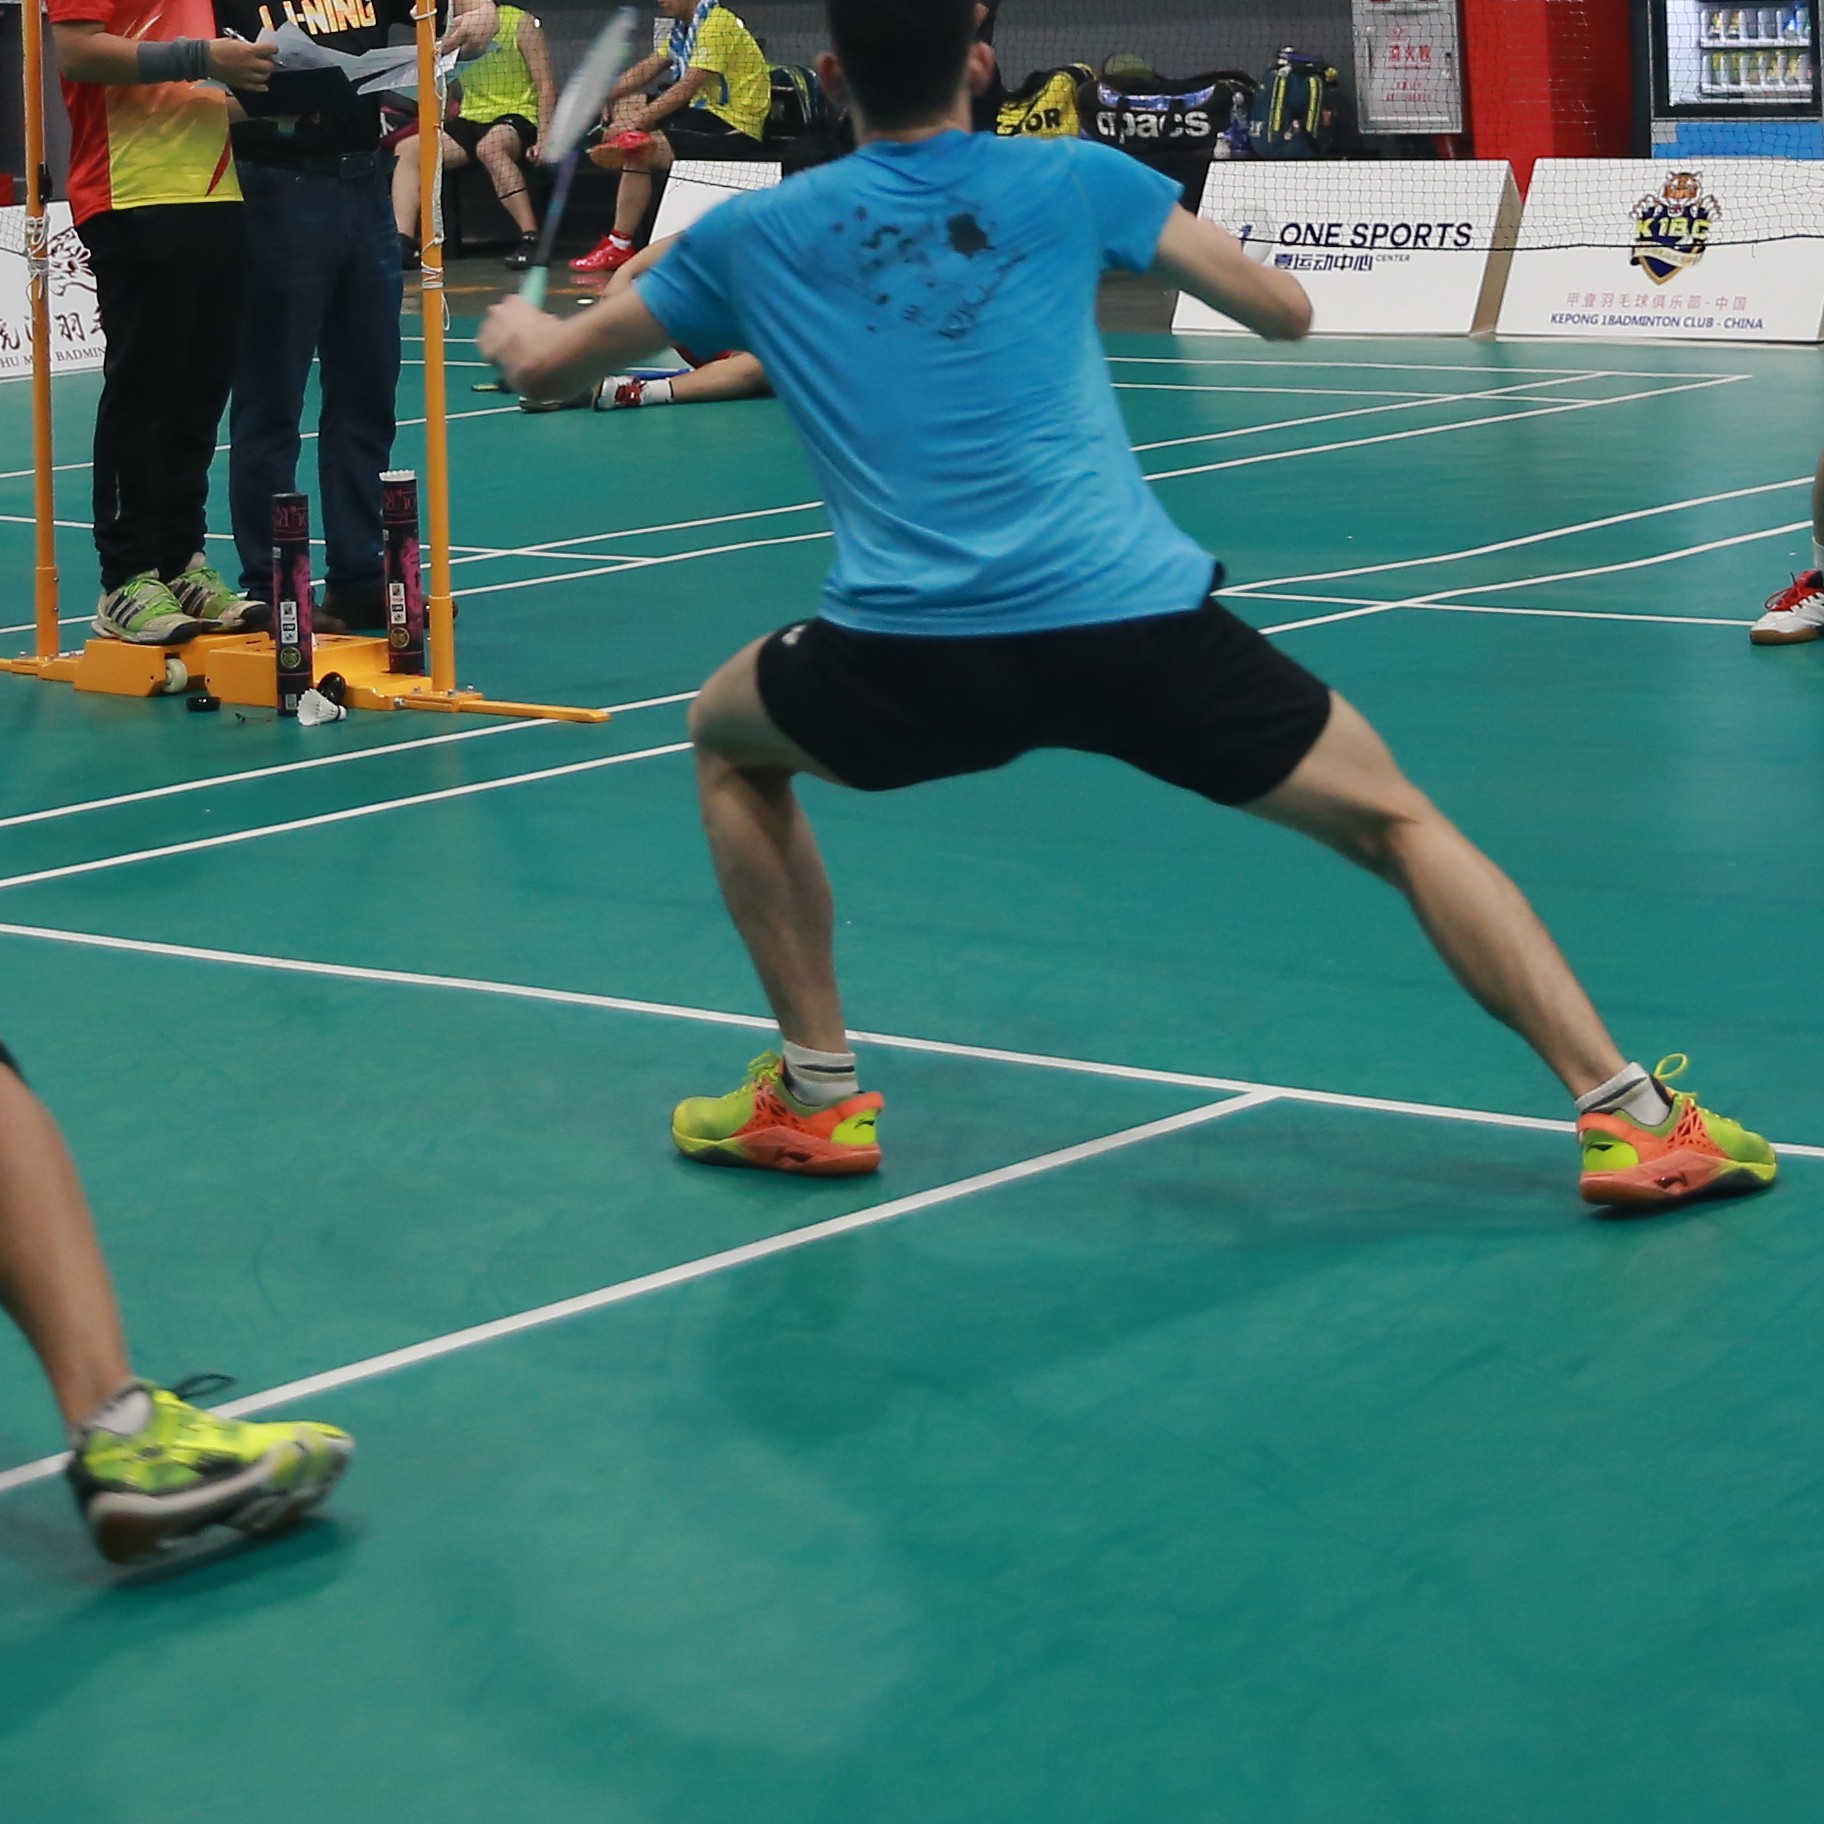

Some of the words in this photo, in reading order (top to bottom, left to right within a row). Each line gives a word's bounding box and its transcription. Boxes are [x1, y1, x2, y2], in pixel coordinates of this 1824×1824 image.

[1280, 222, 1344, 247] ONE
[1350, 222, 1473, 247] SPORTS
[1375, 254, 1411, 263] CENTER
[1550, 313, 1599, 325] KEPONG
[1683, 316, 1714, 329] CLUB
[1723, 317, 1764, 330] CHINA
[0, 356, 20, 368] HU
